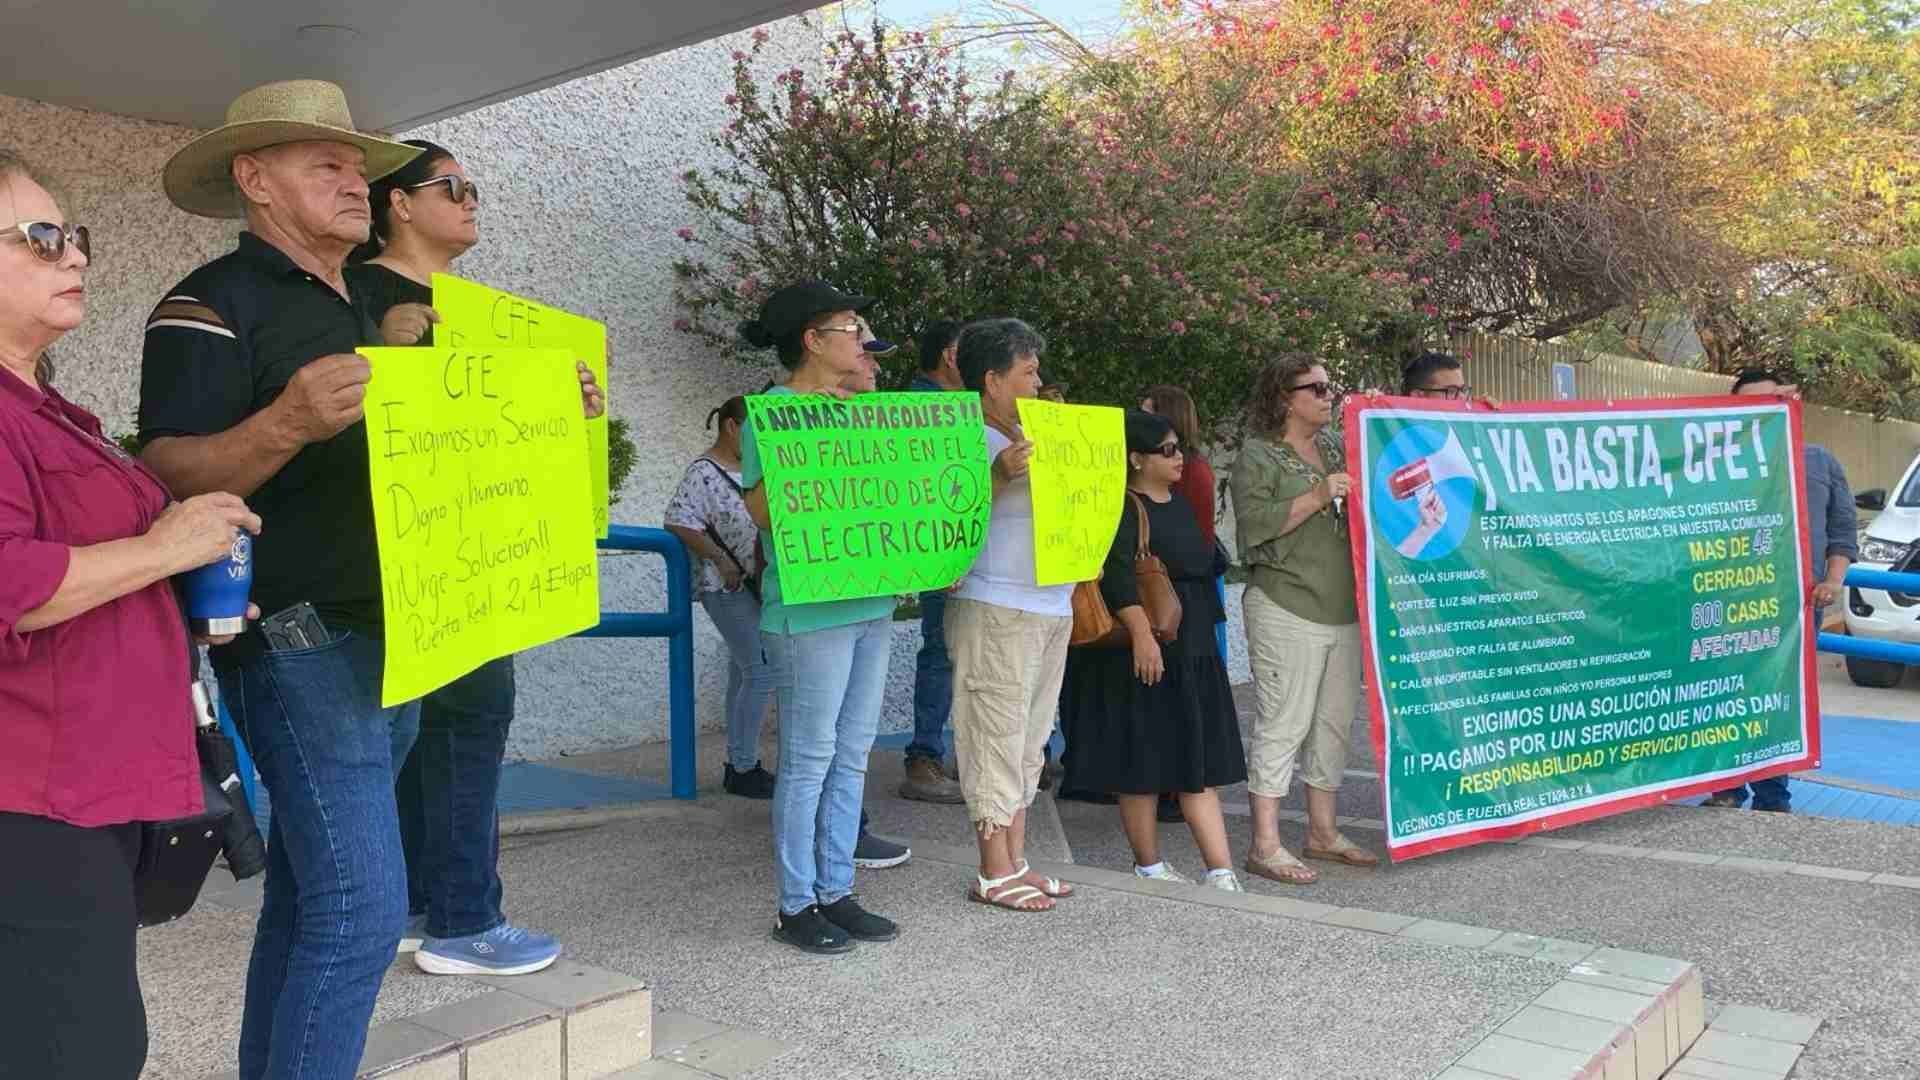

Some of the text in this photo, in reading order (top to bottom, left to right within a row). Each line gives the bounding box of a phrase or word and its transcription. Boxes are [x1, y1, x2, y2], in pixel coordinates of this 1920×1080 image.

[443, 353, 499, 400] CFE
[381, 401, 569, 476] Exigimos un Servicio
[776, 436, 967, 469] NO FALLAS EN EL
[1545, 424, 1674, 499] BASTA,
[387, 483, 449, 541] Digno
[783, 477, 938, 515] SERVICIO DE
[1480, 513, 1540, 531] ESTAMOS
[1585, 511, 1601, 525] DE
[1602, 509, 1625, 524] LOS
[1627, 505, 1686, 523] APAGONES
[1687, 499, 1758, 517] CONSTANTES
[1481, 535, 1491, 550] Y
[1492, 534, 1533, 549] FALTA
[1536, 532, 1551, 547] DE
[1662, 523, 1679, 538] EN
[1679, 519, 1731, 536] NUESTRA
[1731, 513, 1784, 531] COMUNIDAD
[781, 519, 984, 566] ELECTRICIDAD
[1689, 538, 1727, 562] MAS
[1730, 536, 1750, 558] DE
[1693, 563, 1776, 593] CERRADAS
[1396, 590, 1538, 611] CORTE DE LUZ SIN PREVIO AVISO
[1691, 597, 1779, 631] 800 CASAS
[1434, 619, 1486, 634] NUESTROS
[1487, 615, 1533, 629] APARATOS
[1455, 645, 1477, 657] POR
[1478, 642, 1507, 655] FALTA
[1507, 640, 1520, 652] DE
[1521, 634, 1576, 651] ALUMBRADO
[1690, 626, 1781, 663] AFECTADAS
[1497, 665, 1514, 678] SIN
[1515, 658, 1579, 677] VENTILADORES
[1580, 655, 1590, 667] NI
[1463, 673, 1745, 738] EXIGIMOS UNA SOLUCIÓN INMEDIATA
[1472, 694, 1489, 706] LAS
[1491, 689, 1531, 703] FAMILIAS
[1532, 686, 1551, 698] CON
[1553, 680, 1579, 696] NIÑOS
[1594, 673, 1637, 689] PERSONAS
[1638, 668, 1673, 684] MAYORES
[1420, 737, 1507, 774] PAGAMOS
[1509, 732, 1548, 758] POR
[1551, 727, 1578, 750] UN
[1580, 715, 1654, 746] SERVICIO
[1658, 708, 1690, 733] QUE
[1692, 703, 1713, 726] NO
[1715, 697, 1748, 720] NOS
[1741, 751, 1753, 764] DE
[1753, 743, 1780, 760] AGOSTO
[1459, 748, 1604, 796] RESPONSABILIDAD
[1608, 745, 1619, 765] Y
[1620, 733, 1688, 763] SERVICIO
[1691, 723, 1740, 749] DIGNO
[1395, 783, 1594, 837] VECINOS DE PUERTA REAL ETAPA 2 Y 4
